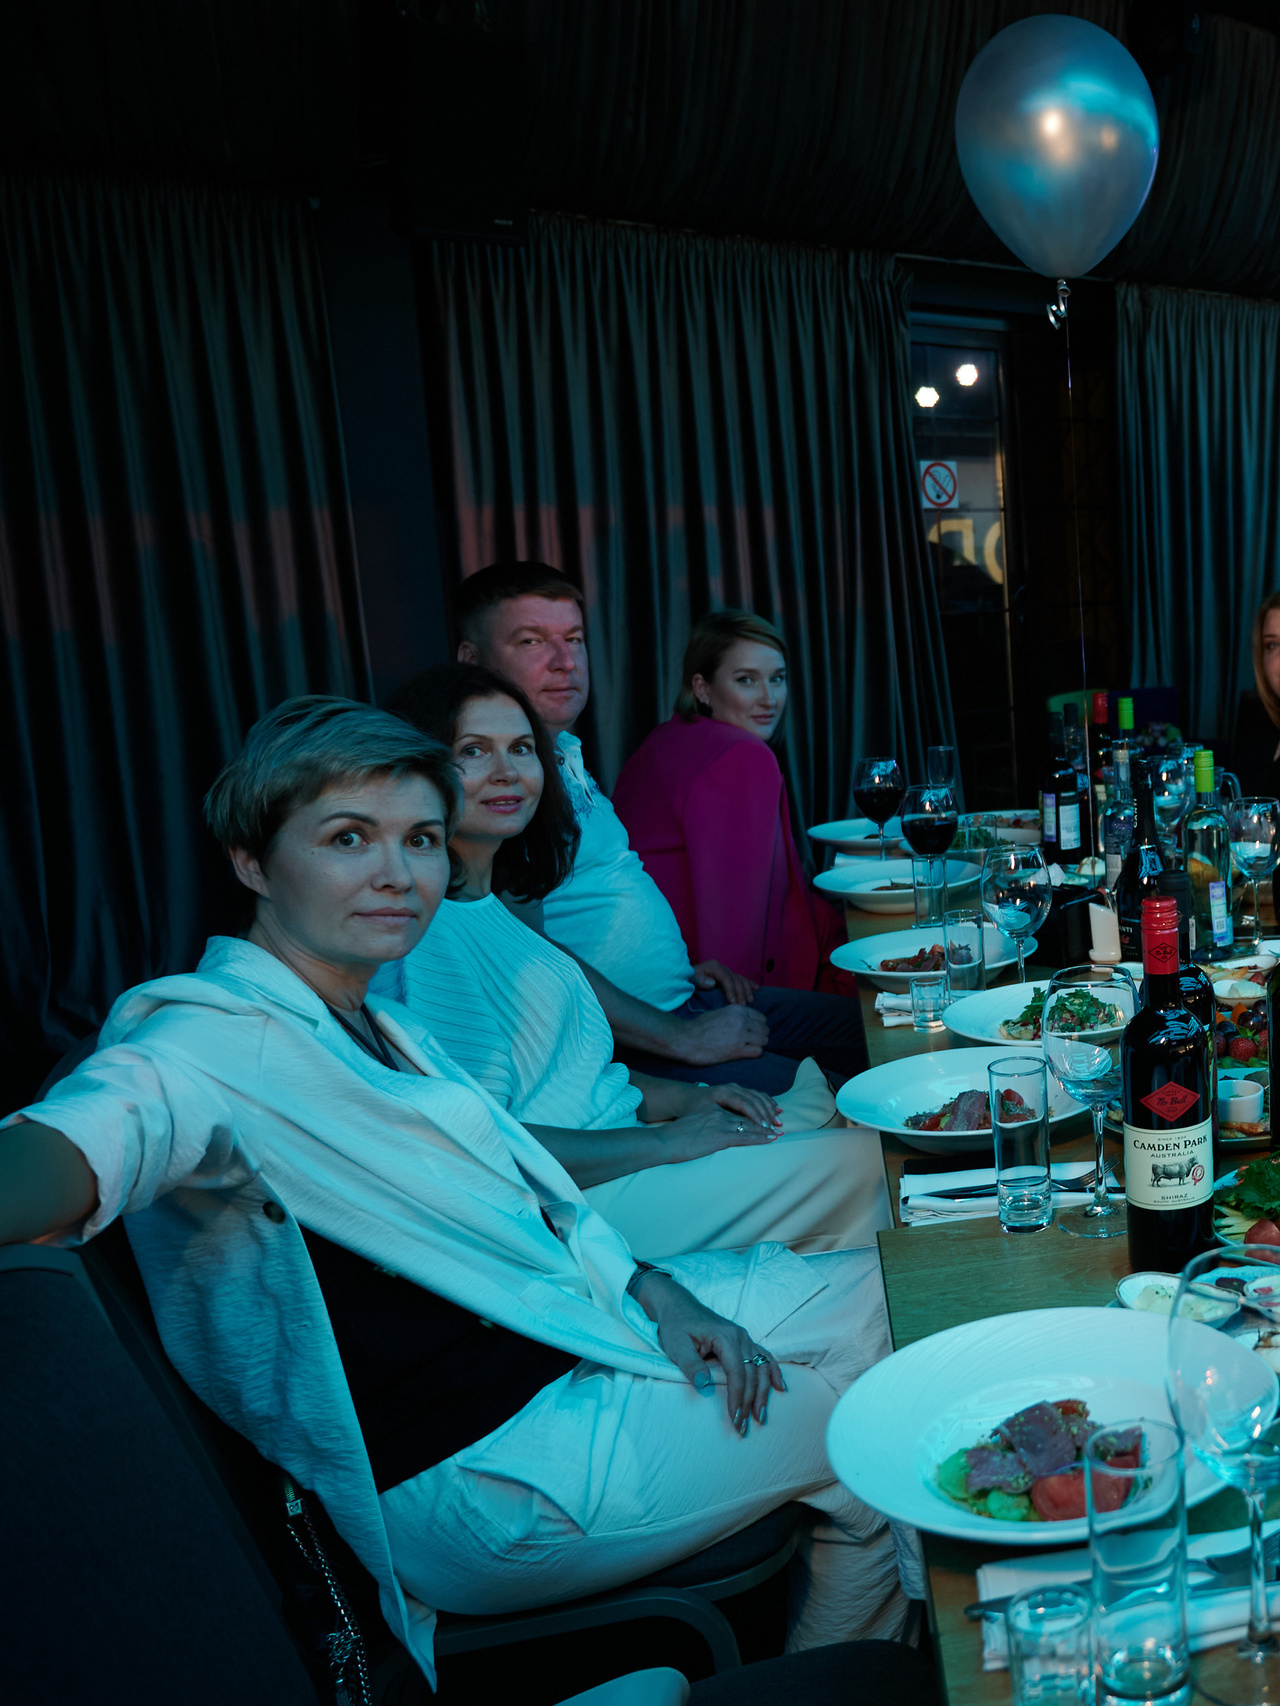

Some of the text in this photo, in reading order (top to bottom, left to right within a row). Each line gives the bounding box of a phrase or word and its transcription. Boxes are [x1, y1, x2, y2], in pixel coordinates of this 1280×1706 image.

[1119, 925, 1133, 933] ANTI
[1133, 1134, 1208, 1151] CAMDEN PARK
[1150, 1150, 1194, 1158] AUSTRALIA
